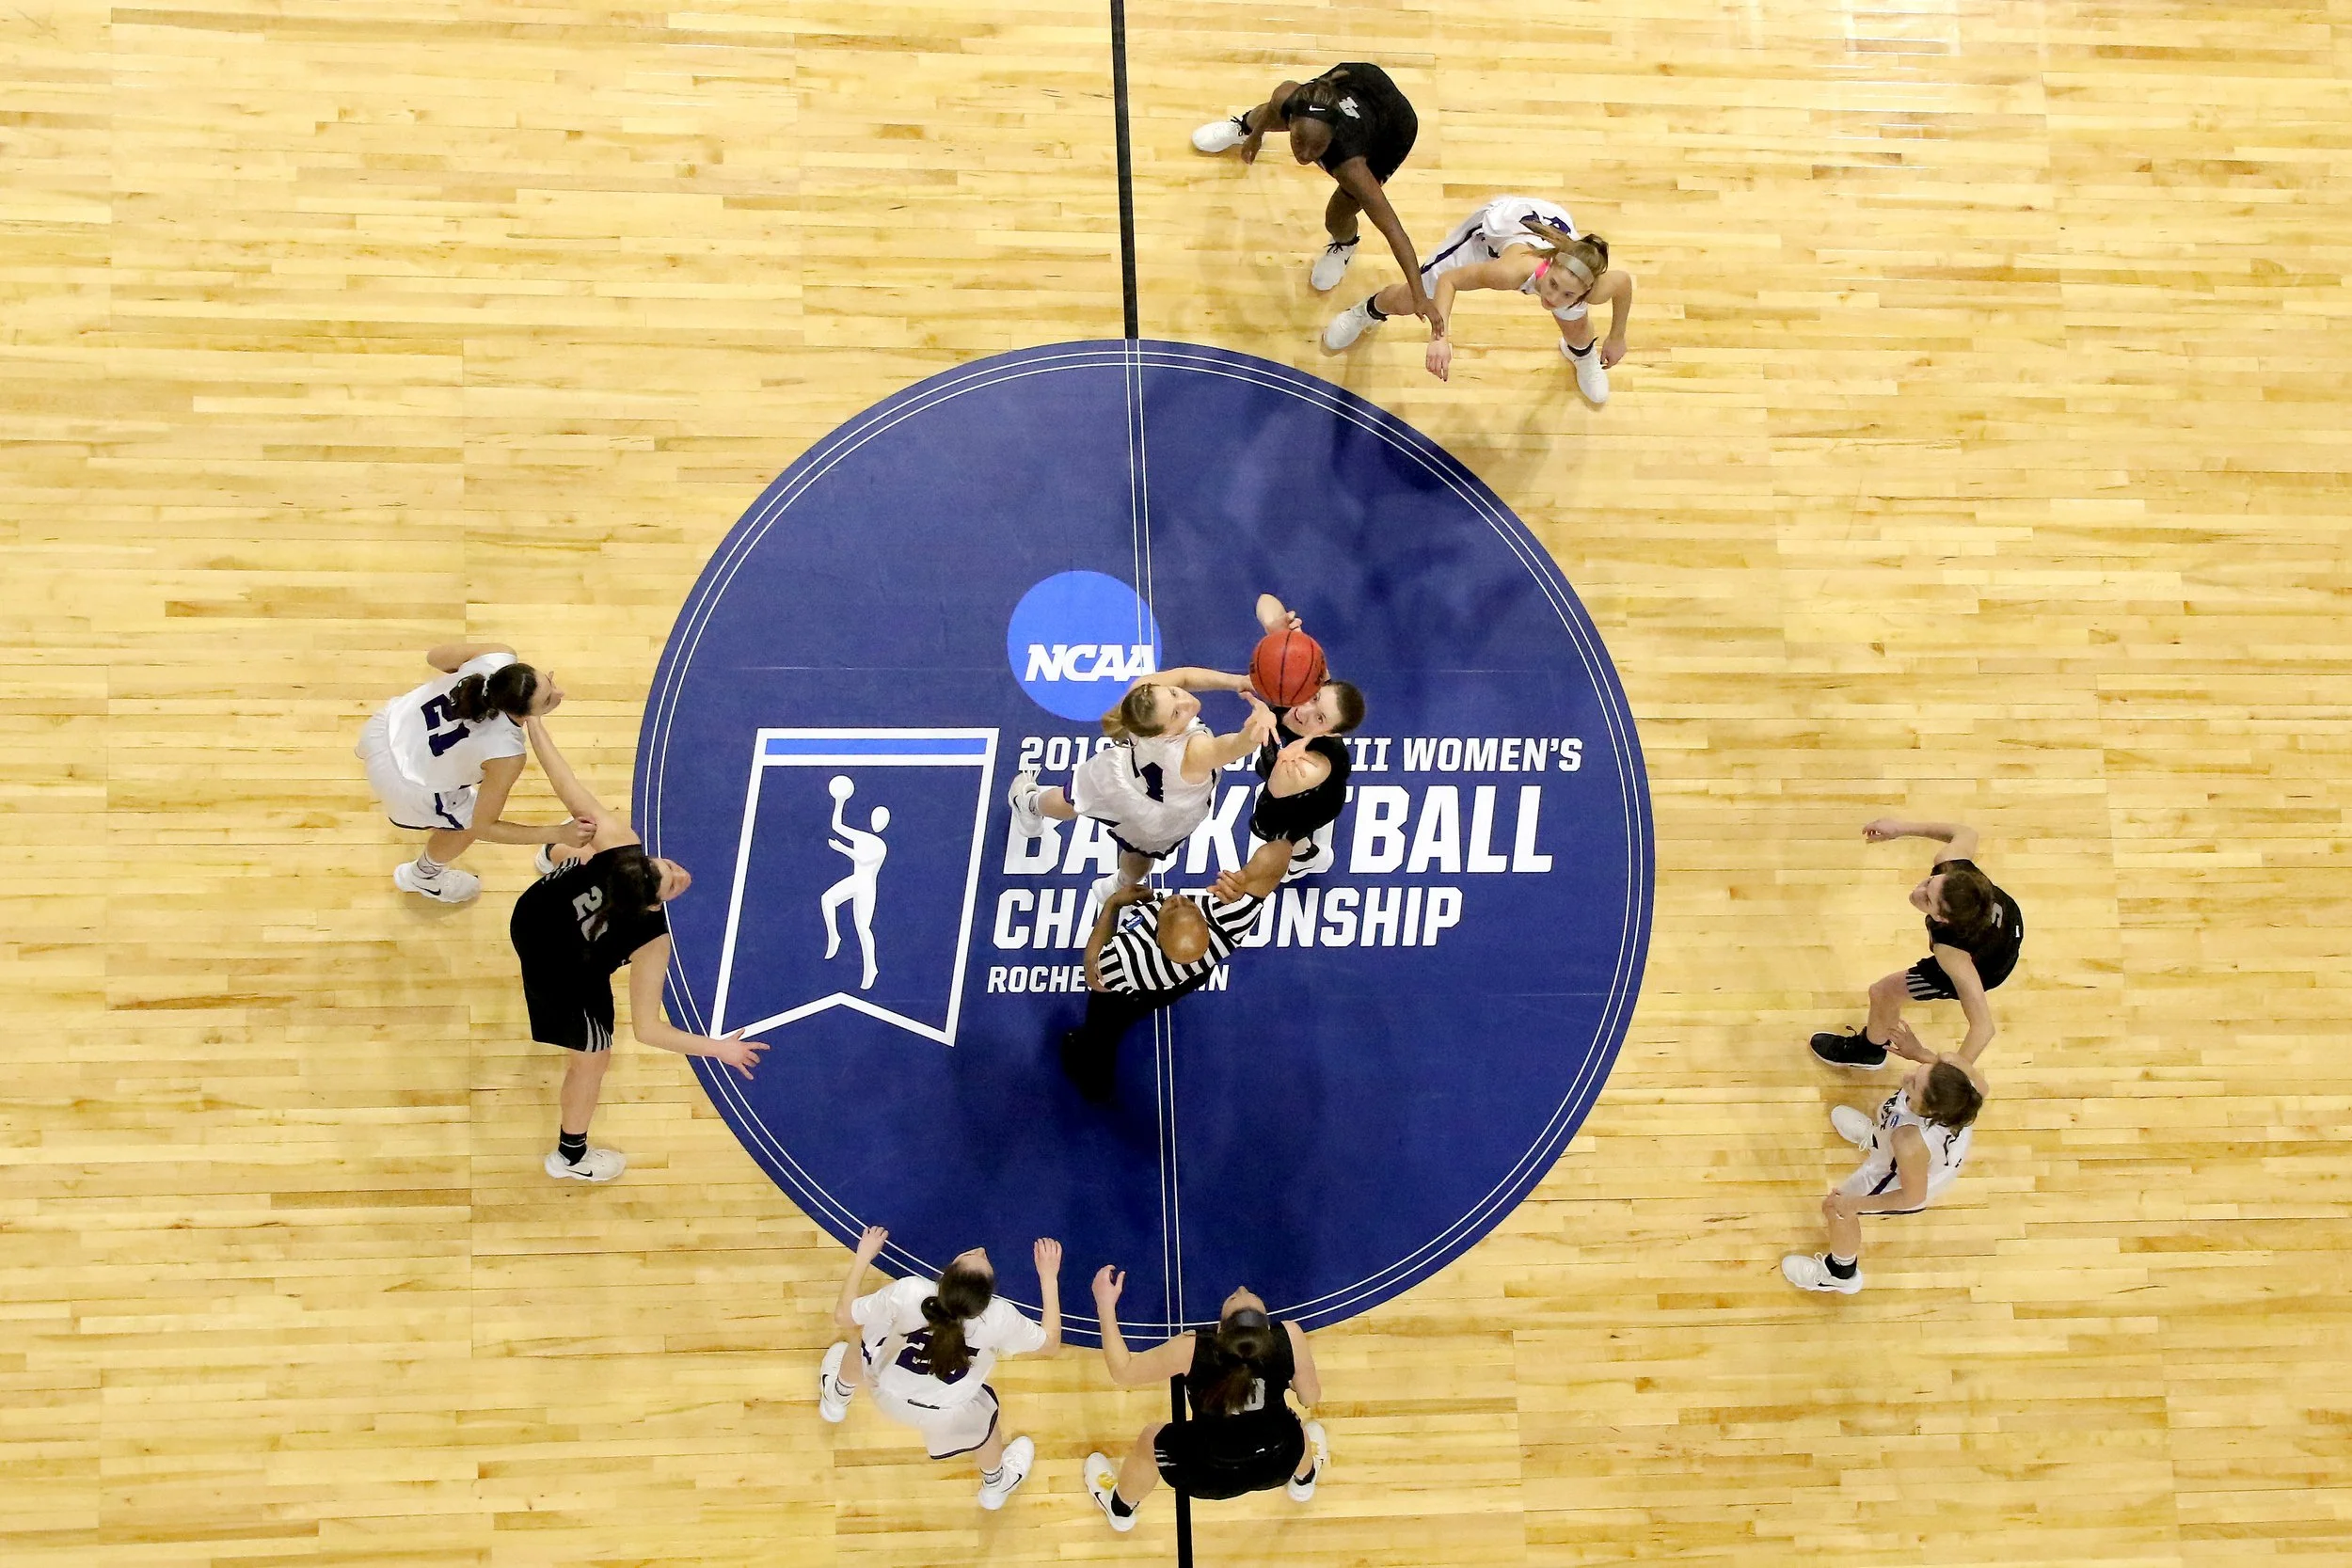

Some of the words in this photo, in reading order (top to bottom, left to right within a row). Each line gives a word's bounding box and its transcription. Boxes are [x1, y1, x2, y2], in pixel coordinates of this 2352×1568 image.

[1025, 643, 1156, 682] NCAA
[421, 693, 470, 757] 21
[1343, 737, 1391, 772] II
[1403, 737, 1582, 772] WOMEN'S
[1003, 784, 1553, 874] BAKBALL
[992, 887, 1463, 949] CHONSHIP
